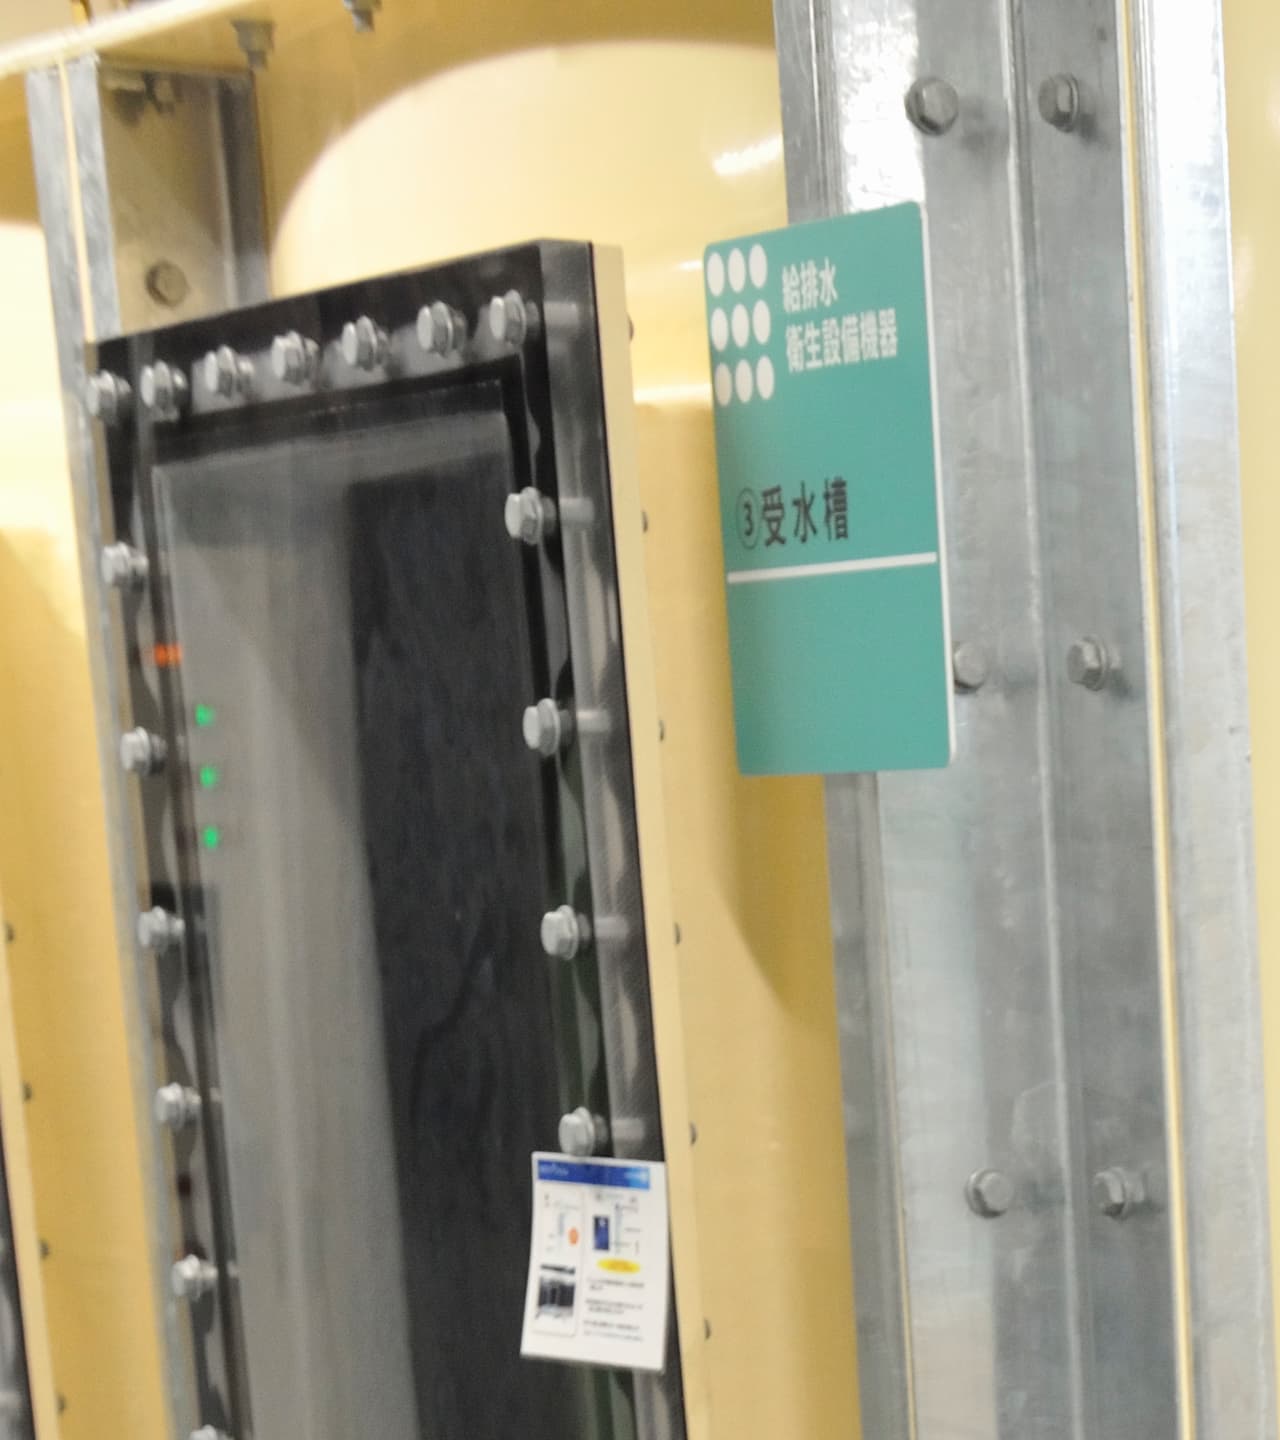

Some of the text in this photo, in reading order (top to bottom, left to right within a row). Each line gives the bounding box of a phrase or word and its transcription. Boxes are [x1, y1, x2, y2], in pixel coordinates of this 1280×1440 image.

[782, 257, 838, 313] 給排水
[785, 307, 898, 372] 衛生設備機器
